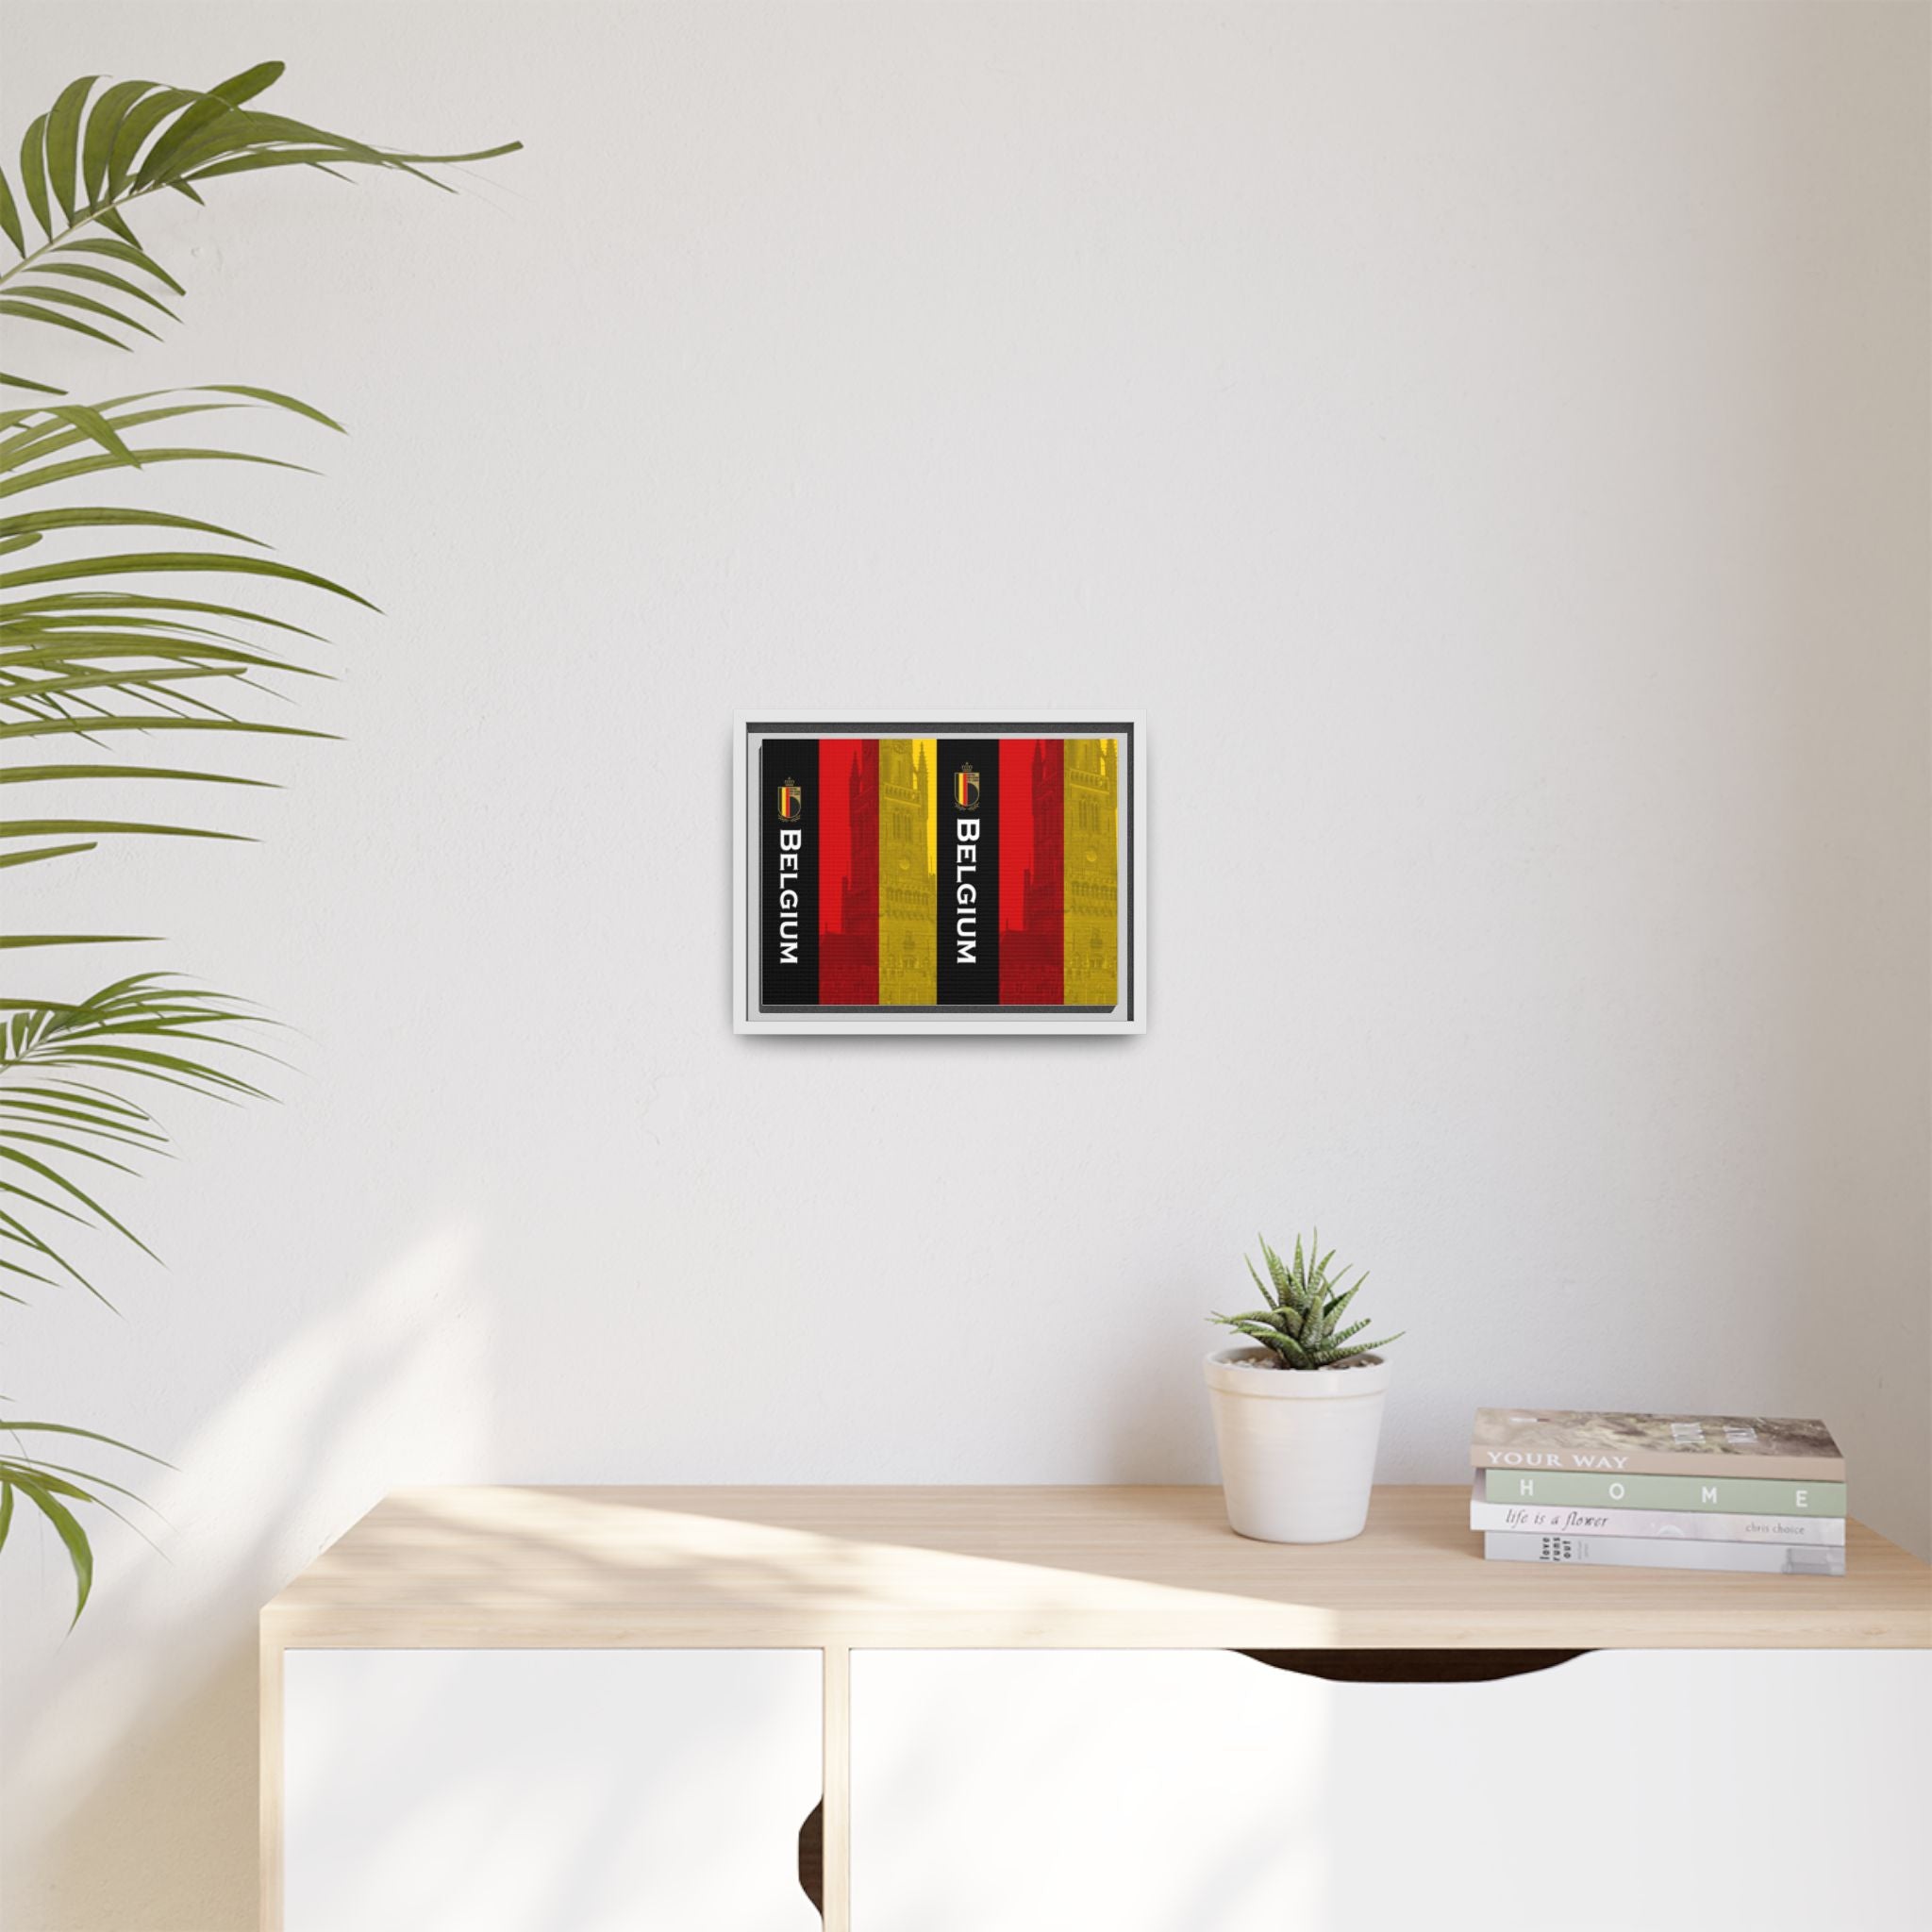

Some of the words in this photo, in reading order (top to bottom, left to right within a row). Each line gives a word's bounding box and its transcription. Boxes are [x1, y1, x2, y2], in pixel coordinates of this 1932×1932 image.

[1488, 1452, 1562, 1466] YOUR
[1573, 1455, 1629, 1469] WAY
[1506, 1509, 1528, 1528] life
[1534, 1512, 1545, 1524] is
[1551, 1516, 1559, 1525] a
[1562, 1511, 1608, 1531] flower
[1540, 1538, 1550, 1559] love
[1562, 1541, 1571, 1558] out
